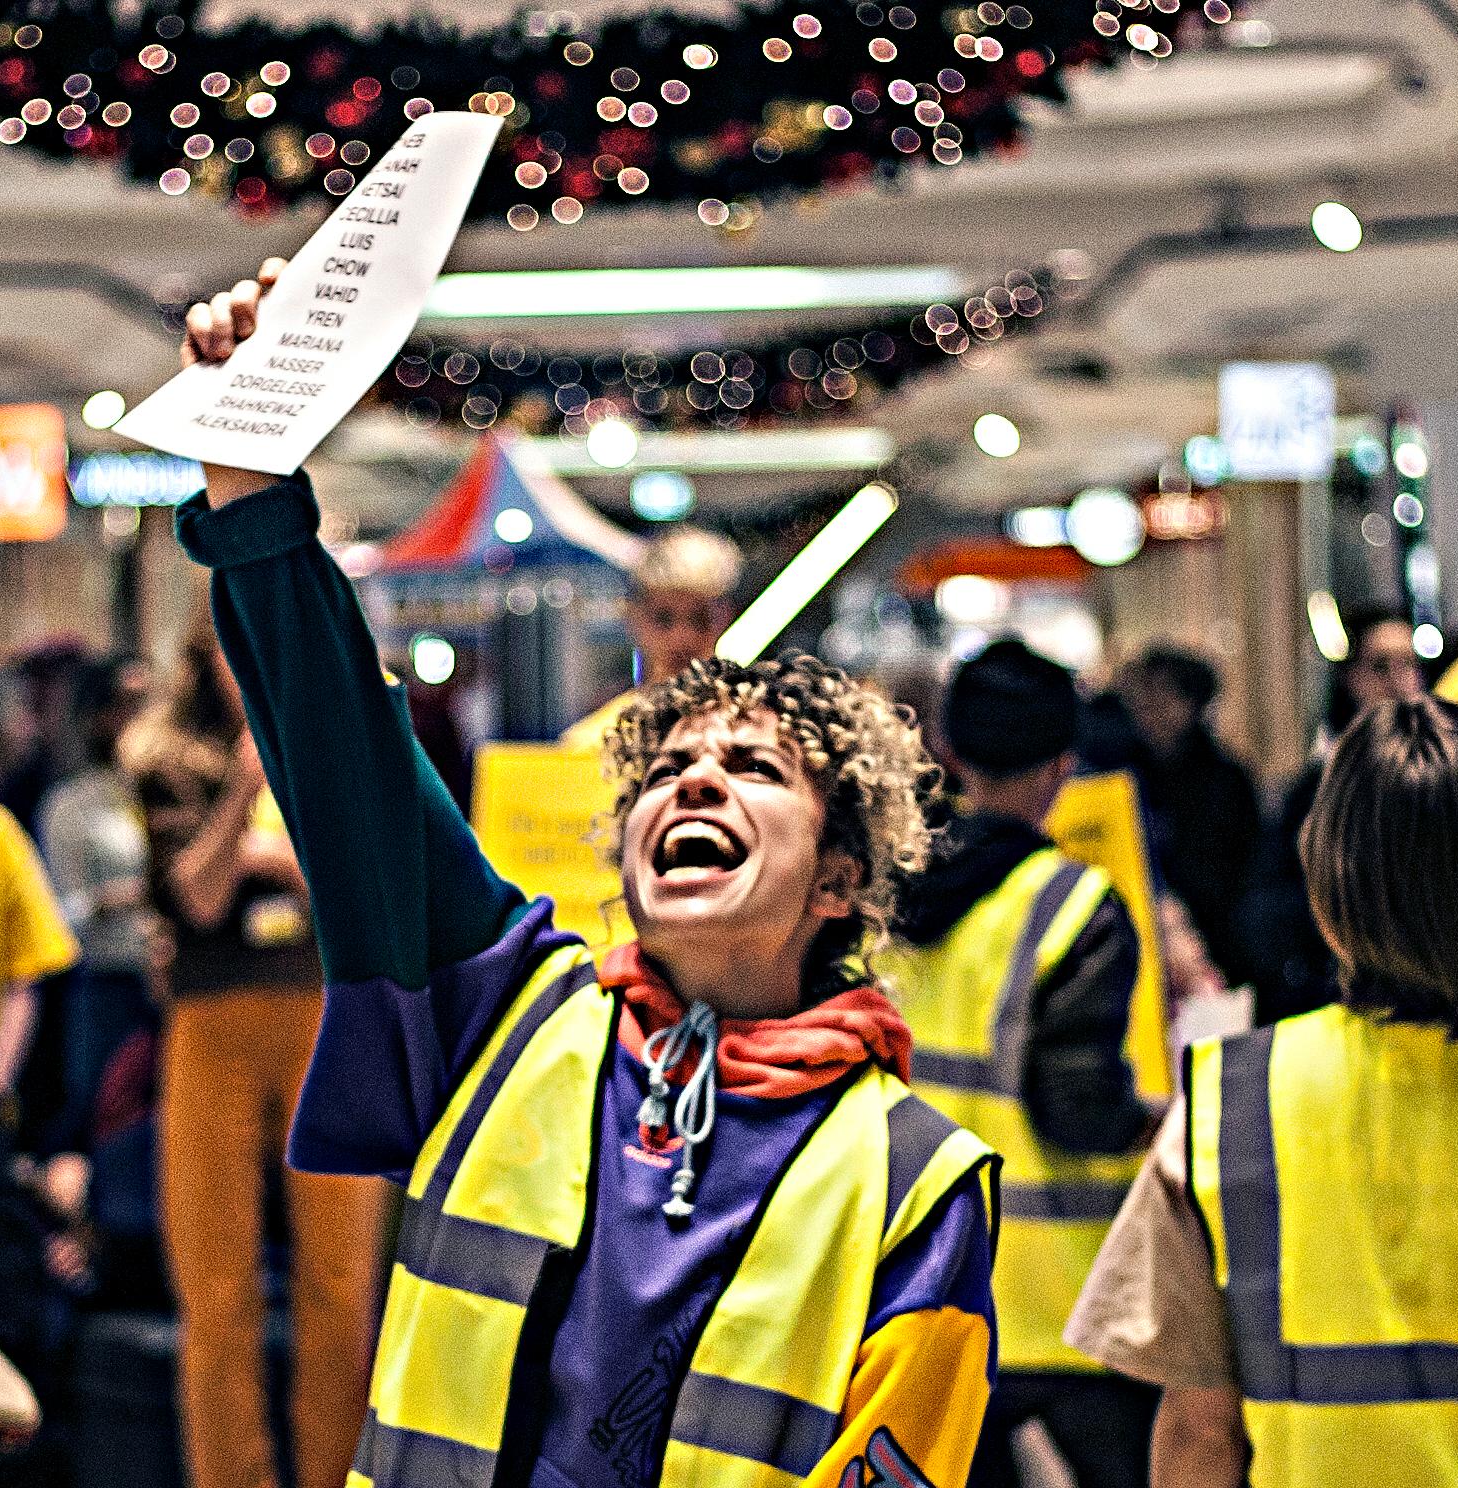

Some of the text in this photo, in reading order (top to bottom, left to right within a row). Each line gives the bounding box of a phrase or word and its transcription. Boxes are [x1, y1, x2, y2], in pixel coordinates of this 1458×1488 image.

[339, 231, 375, 251] LUIS
[323, 256, 372, 277] CHOW
[314, 281, 359, 304] VAHID
[305, 308, 346, 329] YREN
[277, 331, 345, 354] MARIANA
[264, 355, 326, 374] NASSER
[229, 373, 326, 397] DORGELESSE
[214, 396, 306, 417] SHAHNEWAZ
[190, 413, 289, 438] ALEKSANDRA
